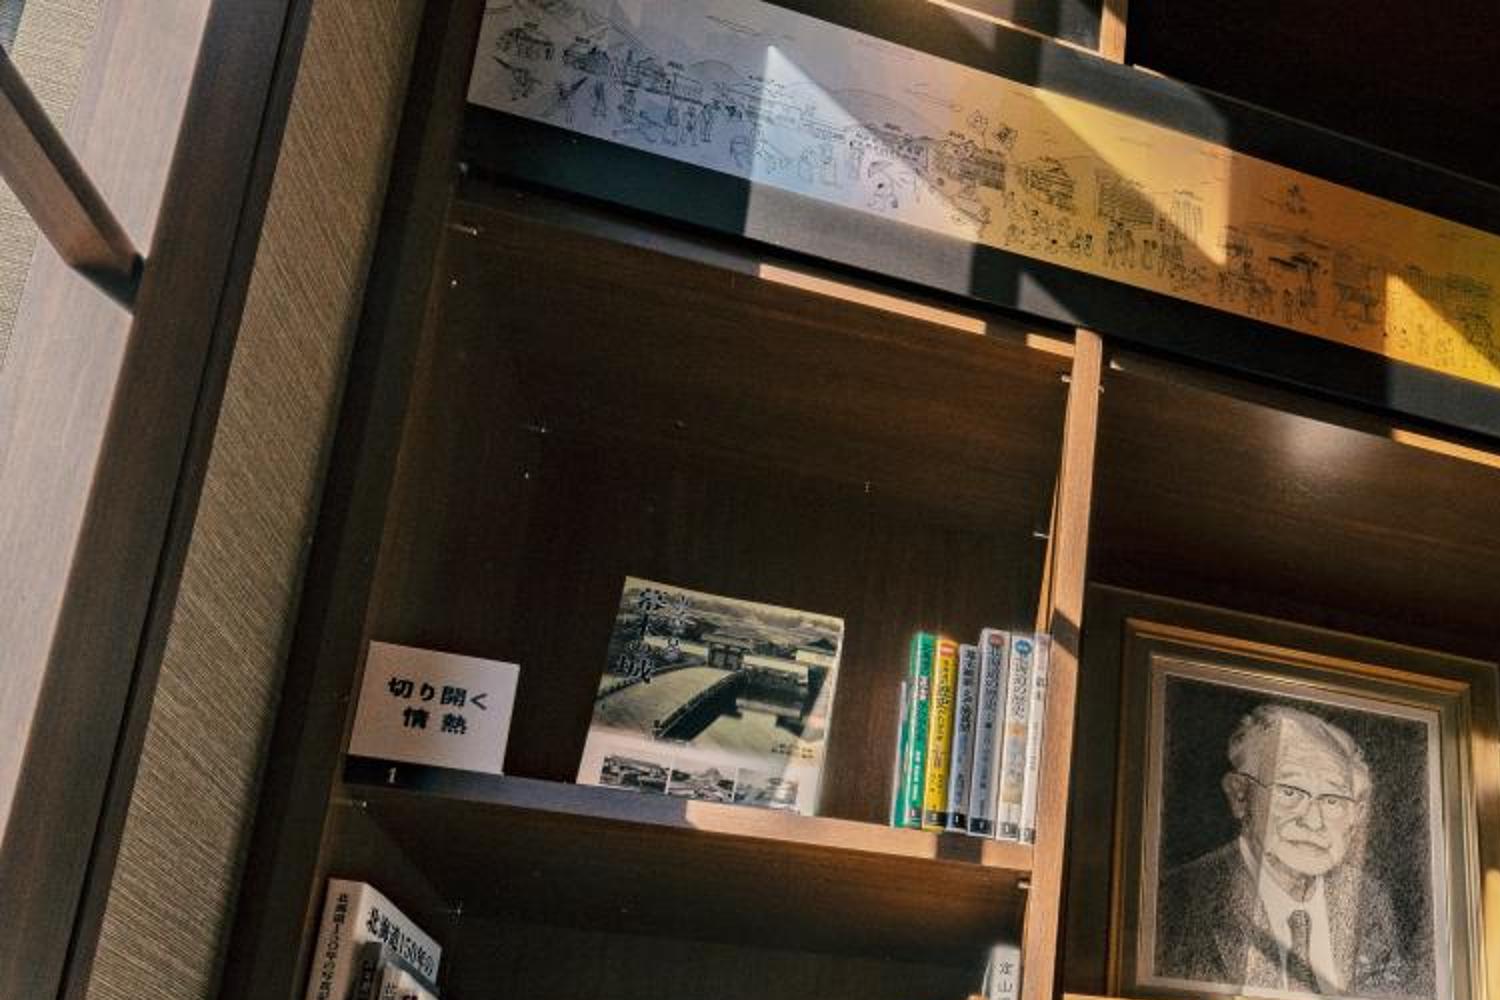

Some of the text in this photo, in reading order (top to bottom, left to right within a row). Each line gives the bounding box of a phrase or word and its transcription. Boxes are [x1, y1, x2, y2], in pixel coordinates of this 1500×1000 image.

[387, 677, 488, 711] 切り開く
[402, 706, 467, 735] 情熱
[388, 767, 397, 784] 1
